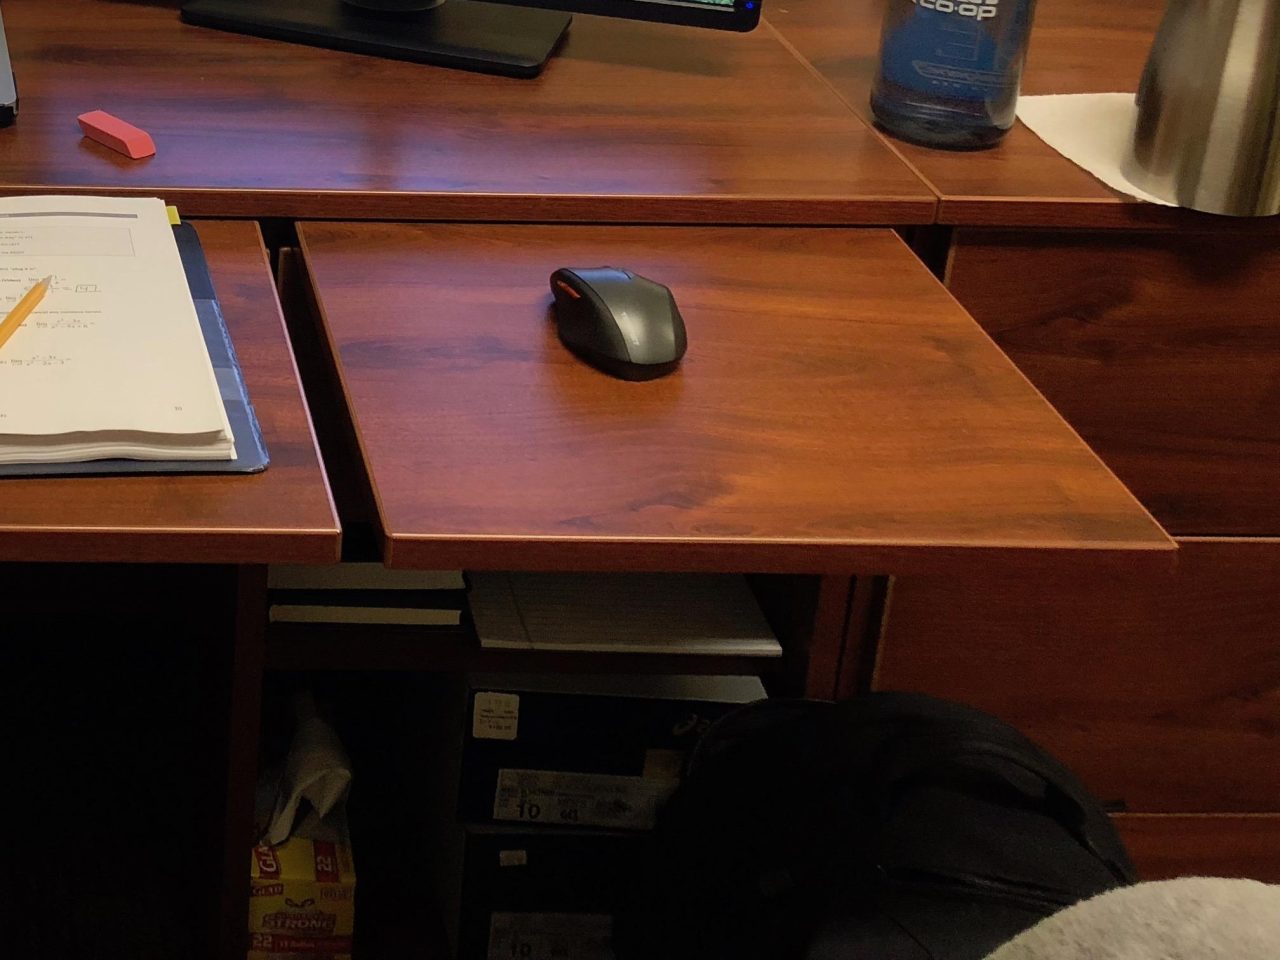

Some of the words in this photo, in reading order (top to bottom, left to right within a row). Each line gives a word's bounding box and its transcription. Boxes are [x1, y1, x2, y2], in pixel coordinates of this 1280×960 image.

[517, 801, 540, 819] 10
[256, 844, 277, 873] GLA
[316, 855, 333, 873] 22
[252, 934, 273, 948] 22
